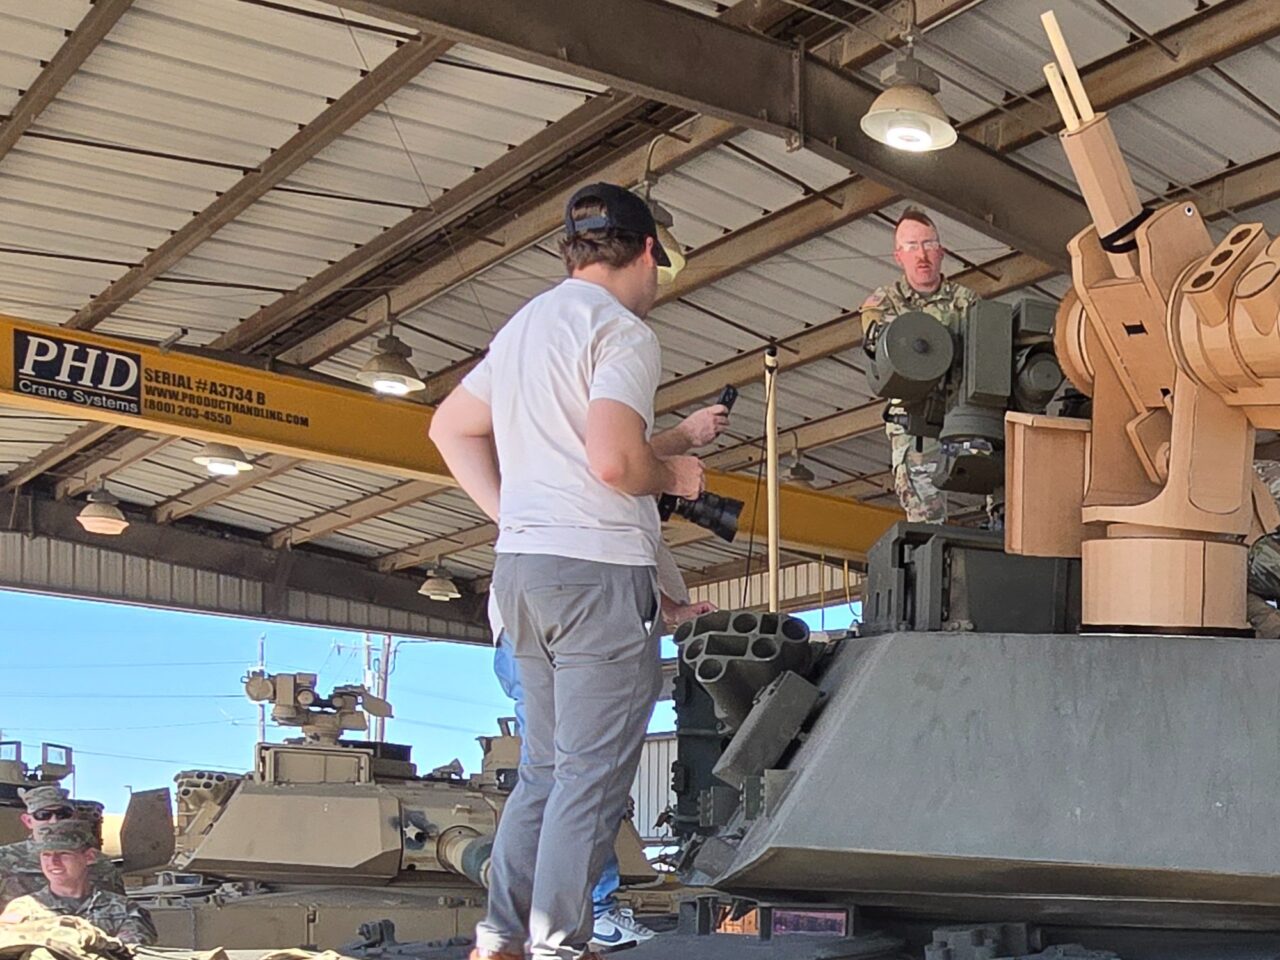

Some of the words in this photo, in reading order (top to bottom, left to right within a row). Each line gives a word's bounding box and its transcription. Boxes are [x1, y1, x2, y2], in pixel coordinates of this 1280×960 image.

[18, 335, 139, 392] PHD
[18, 379, 68, 400] Crane
[72, 389, 139, 414] Systems
[144, 367, 193, 391] SERIAL
[256, 391, 266, 406] B
[144, 384, 309, 428] WWW.PRODUCTHANDLING.COM
[177, 404, 232, 426] 203-4550
